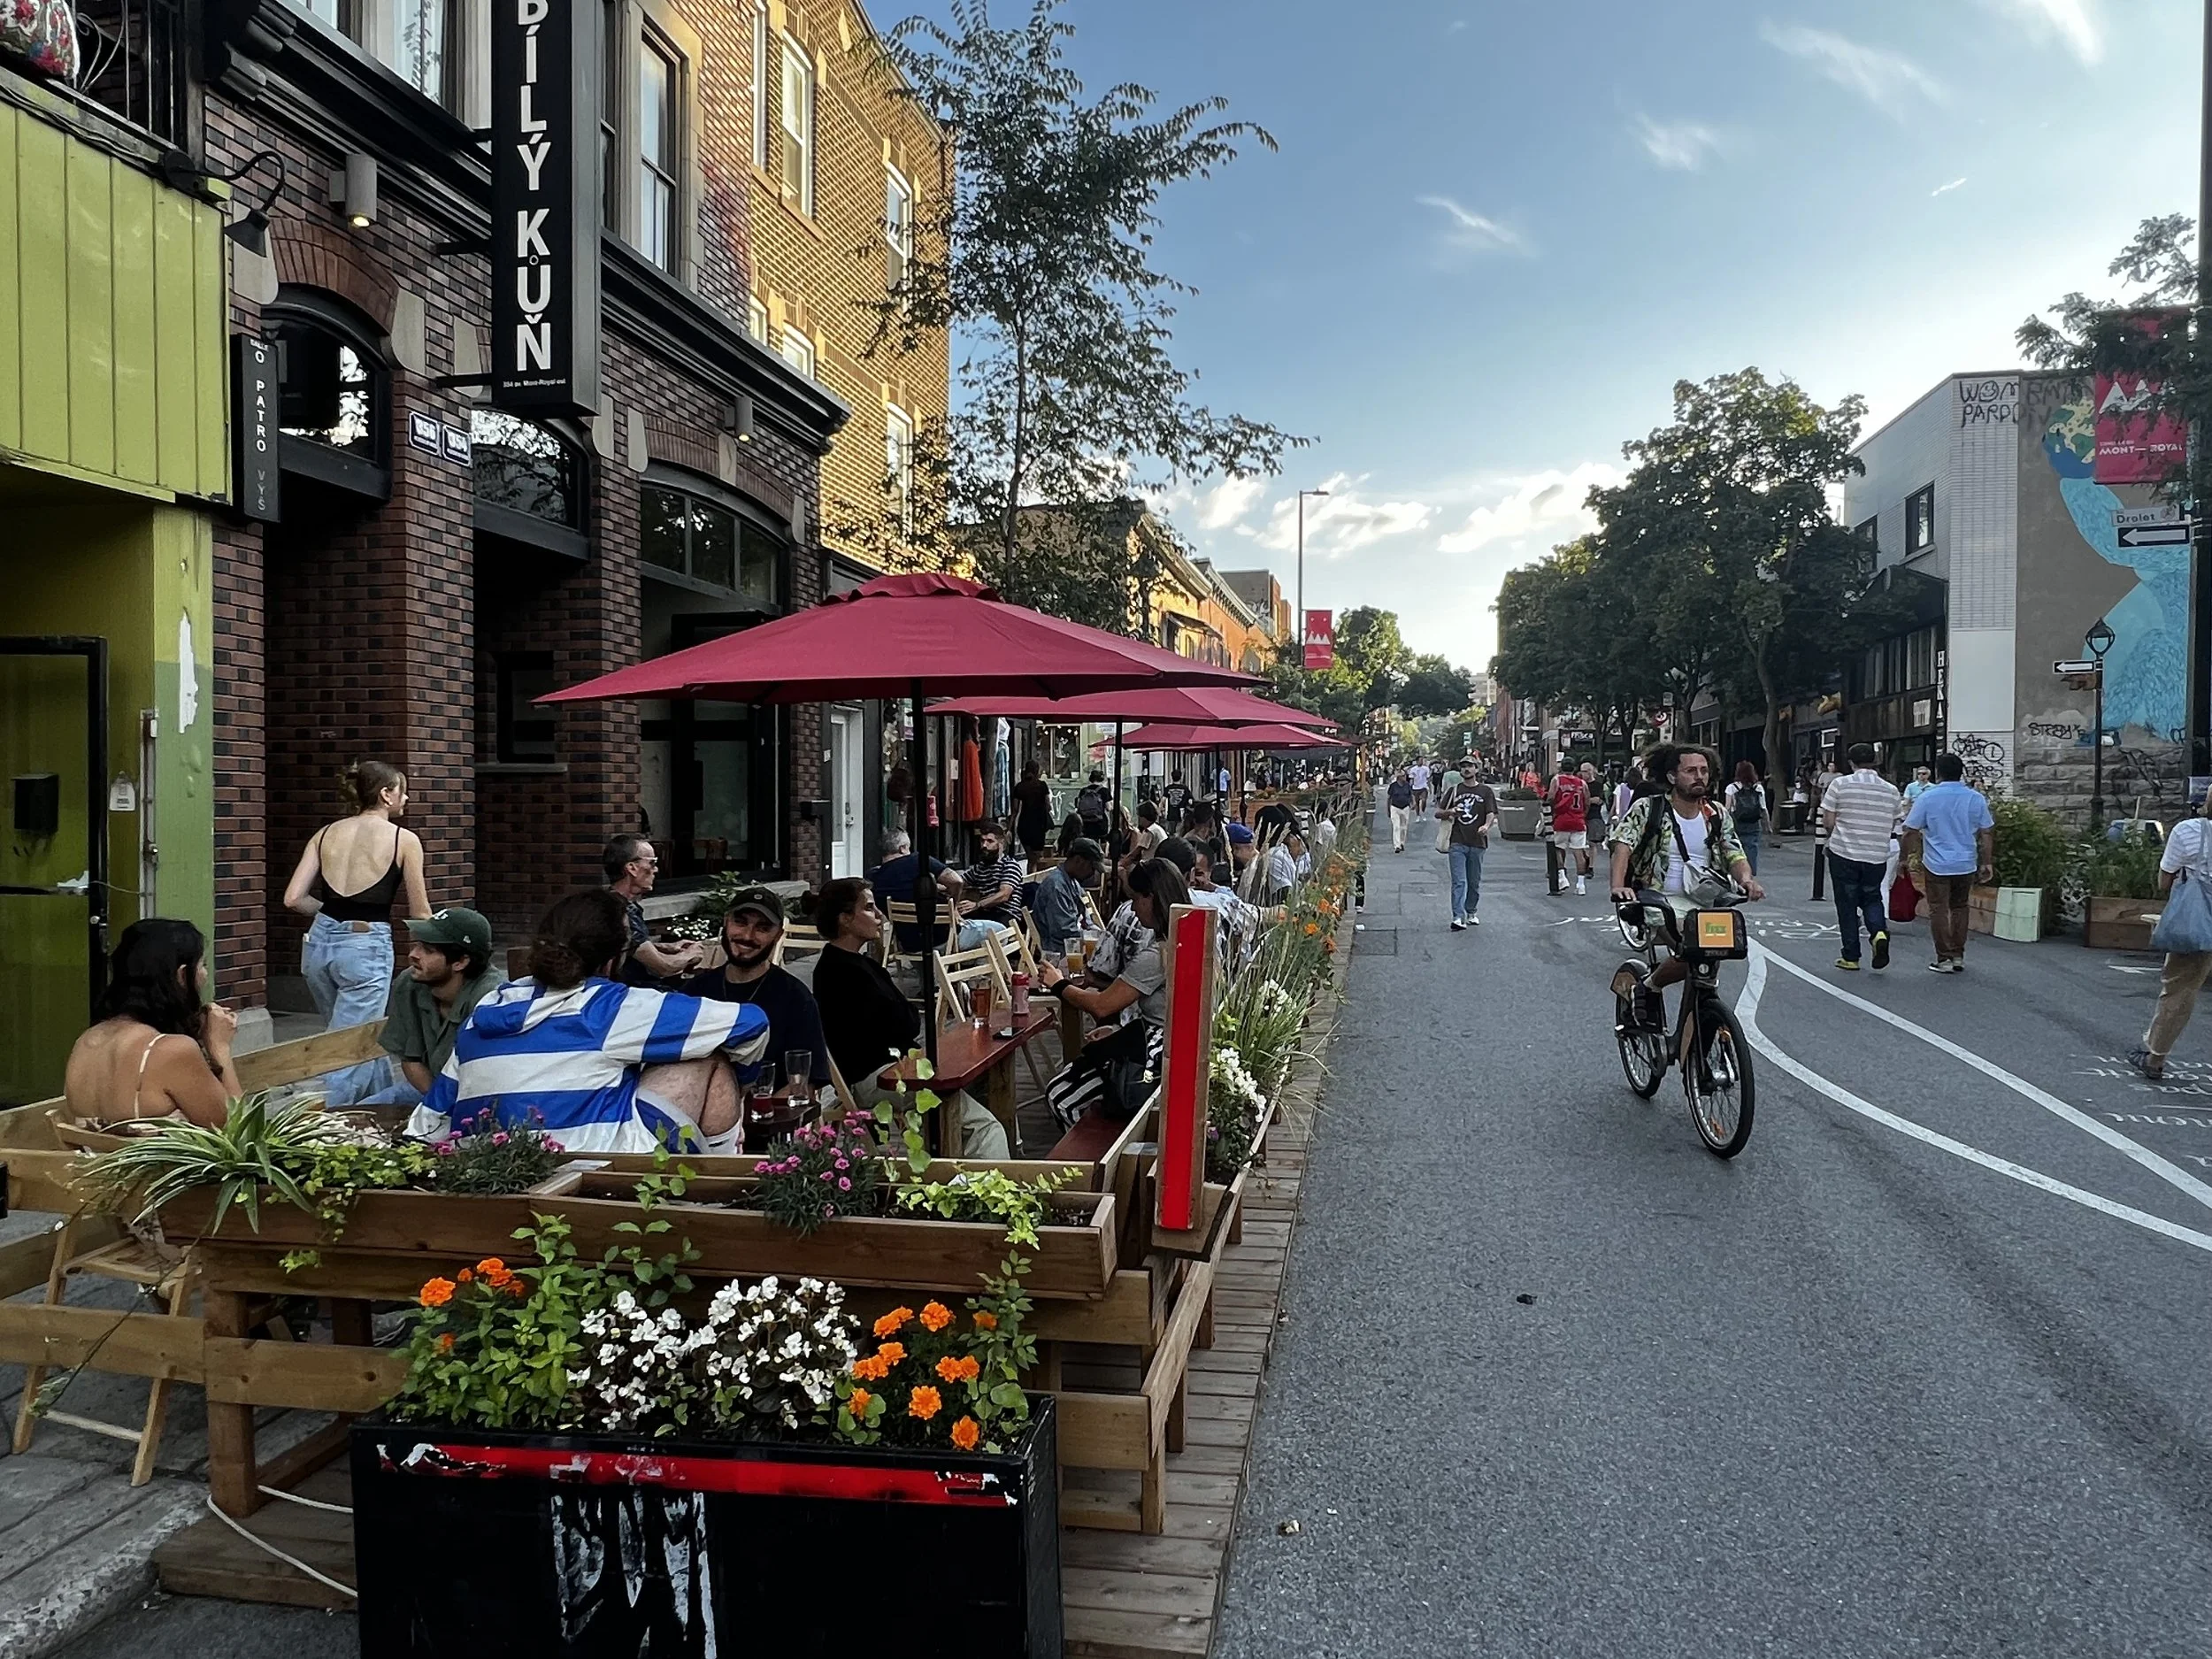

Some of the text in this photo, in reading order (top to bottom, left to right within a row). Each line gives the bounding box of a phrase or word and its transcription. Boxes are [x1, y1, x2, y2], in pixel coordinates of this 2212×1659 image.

[517, 209, 552, 372] KŮŇ
[255, 350, 265, 364] O
[256, 380, 266, 452] PATRO
[2116, 513, 2155, 524] Drolet
